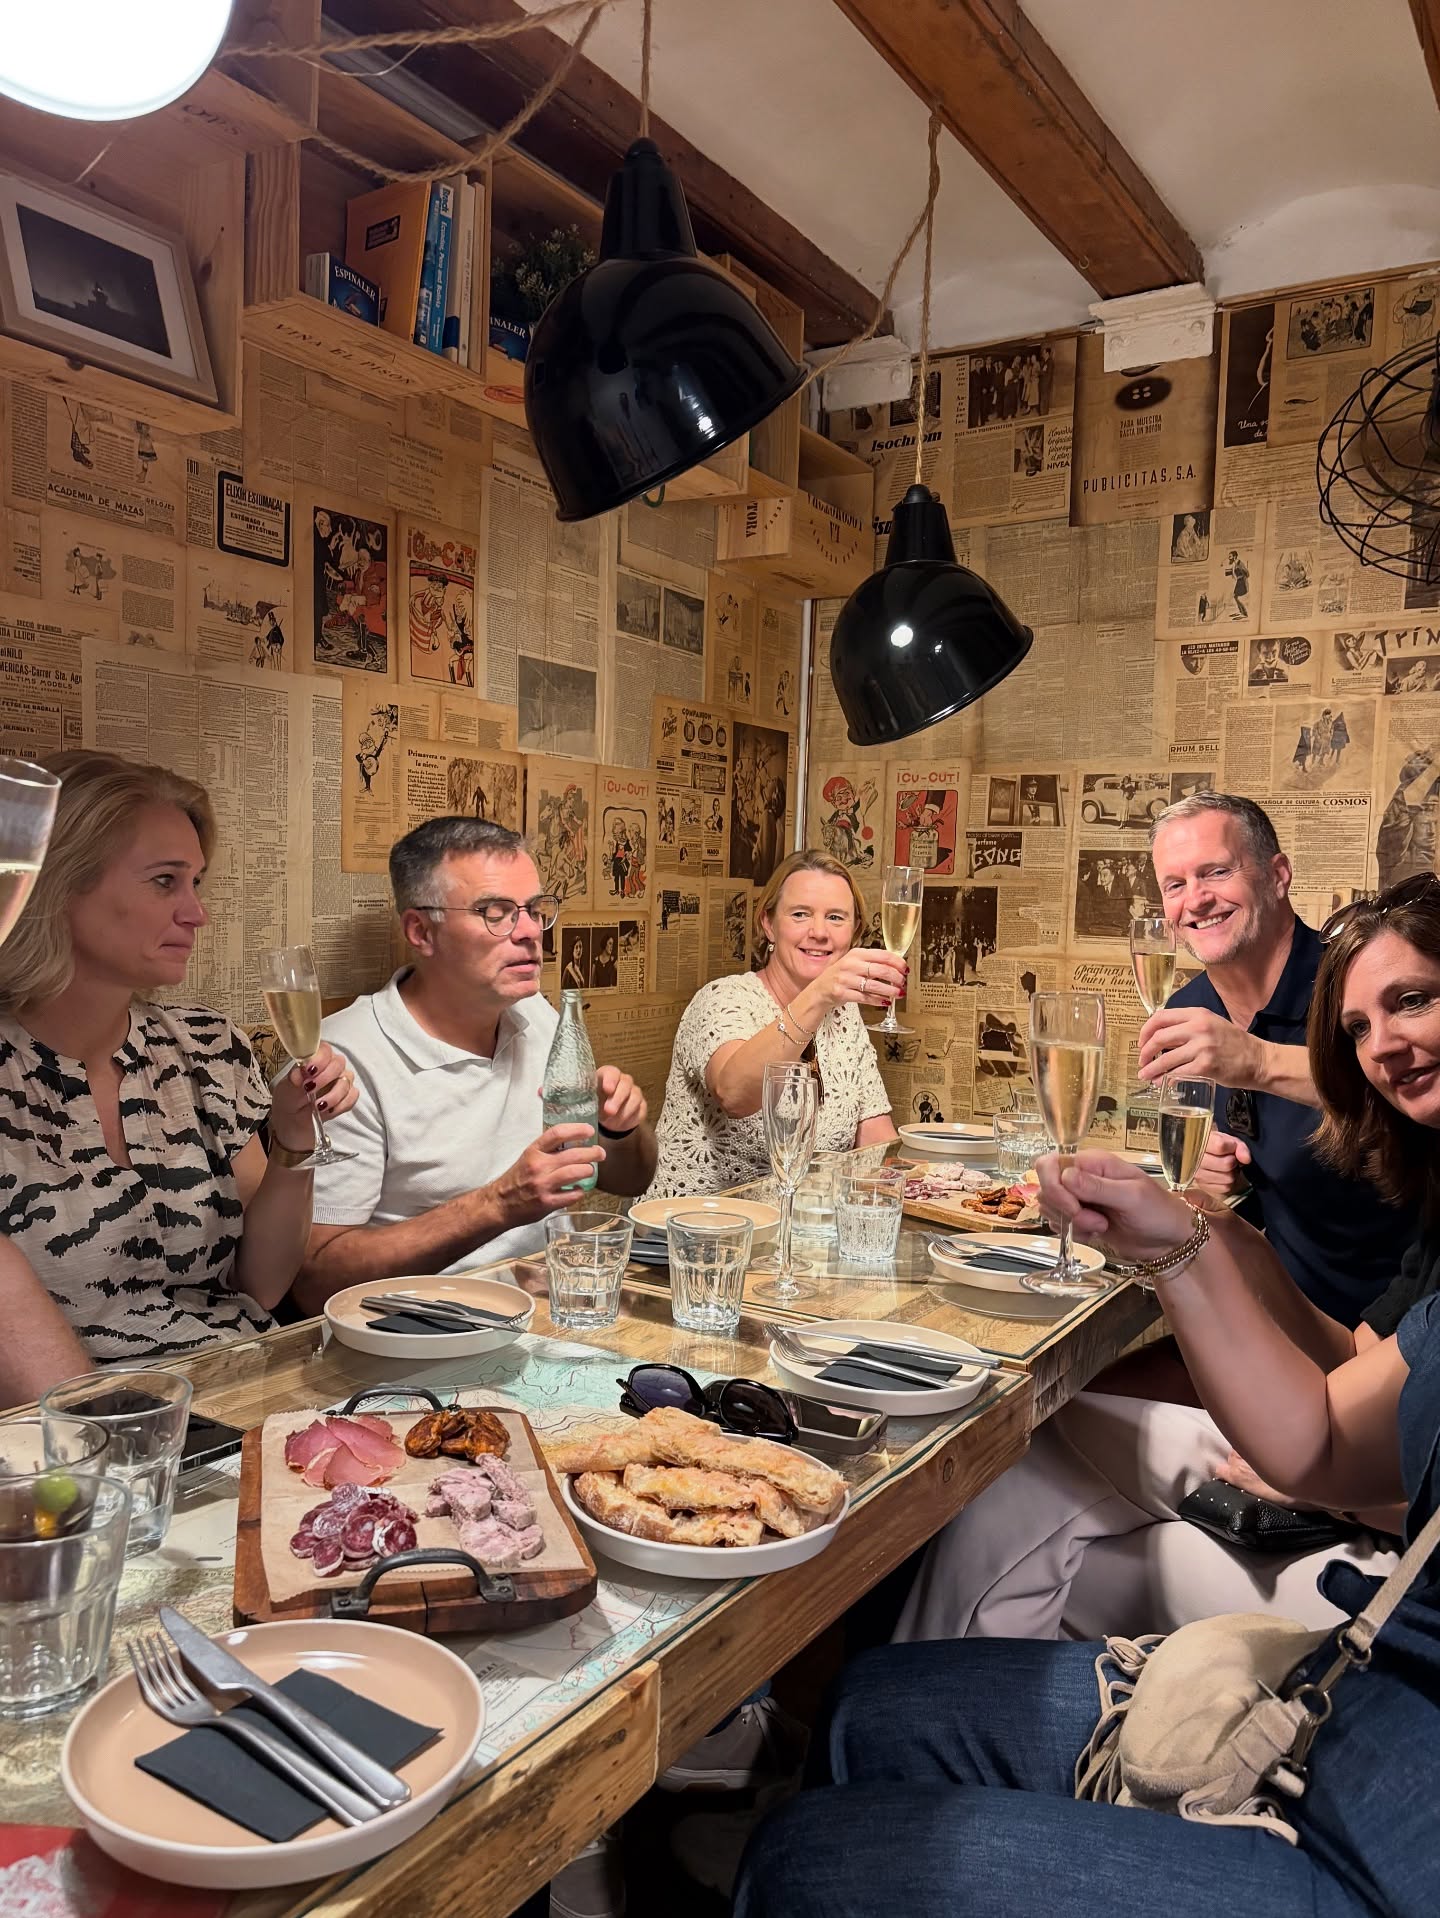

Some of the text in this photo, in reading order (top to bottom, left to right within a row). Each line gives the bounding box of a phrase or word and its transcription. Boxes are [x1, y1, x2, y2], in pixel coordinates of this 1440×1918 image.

[334, 265, 376, 302] ESPINALER
[1238, 420, 1258, 430] Una
[1047, 460, 1070, 471] NIVEA
[1083, 464, 1197, 494] PUBLICITAS, S.A.
[226, 482, 247, 500] ELIXIR
[48, 483, 145, 517] ACADEMIA DE MAZAS
[746, 500, 758, 538] TORA
[14, 630, 35, 642] LLUCH
[5, 674, 73, 690] ULTIMS MODELS
[408, 749, 438, 760] Primavera
[1171, 744, 1220, 753] RHUM BELL
[897, 771, 960, 783] ¡CU-CUT!
[1323, 798, 1368, 806] COSMOS
[1074, 964, 1125, 981] Páginas
[1080, 974, 1106, 985] buen
[1070, 984, 1102, 992] Aventuras
